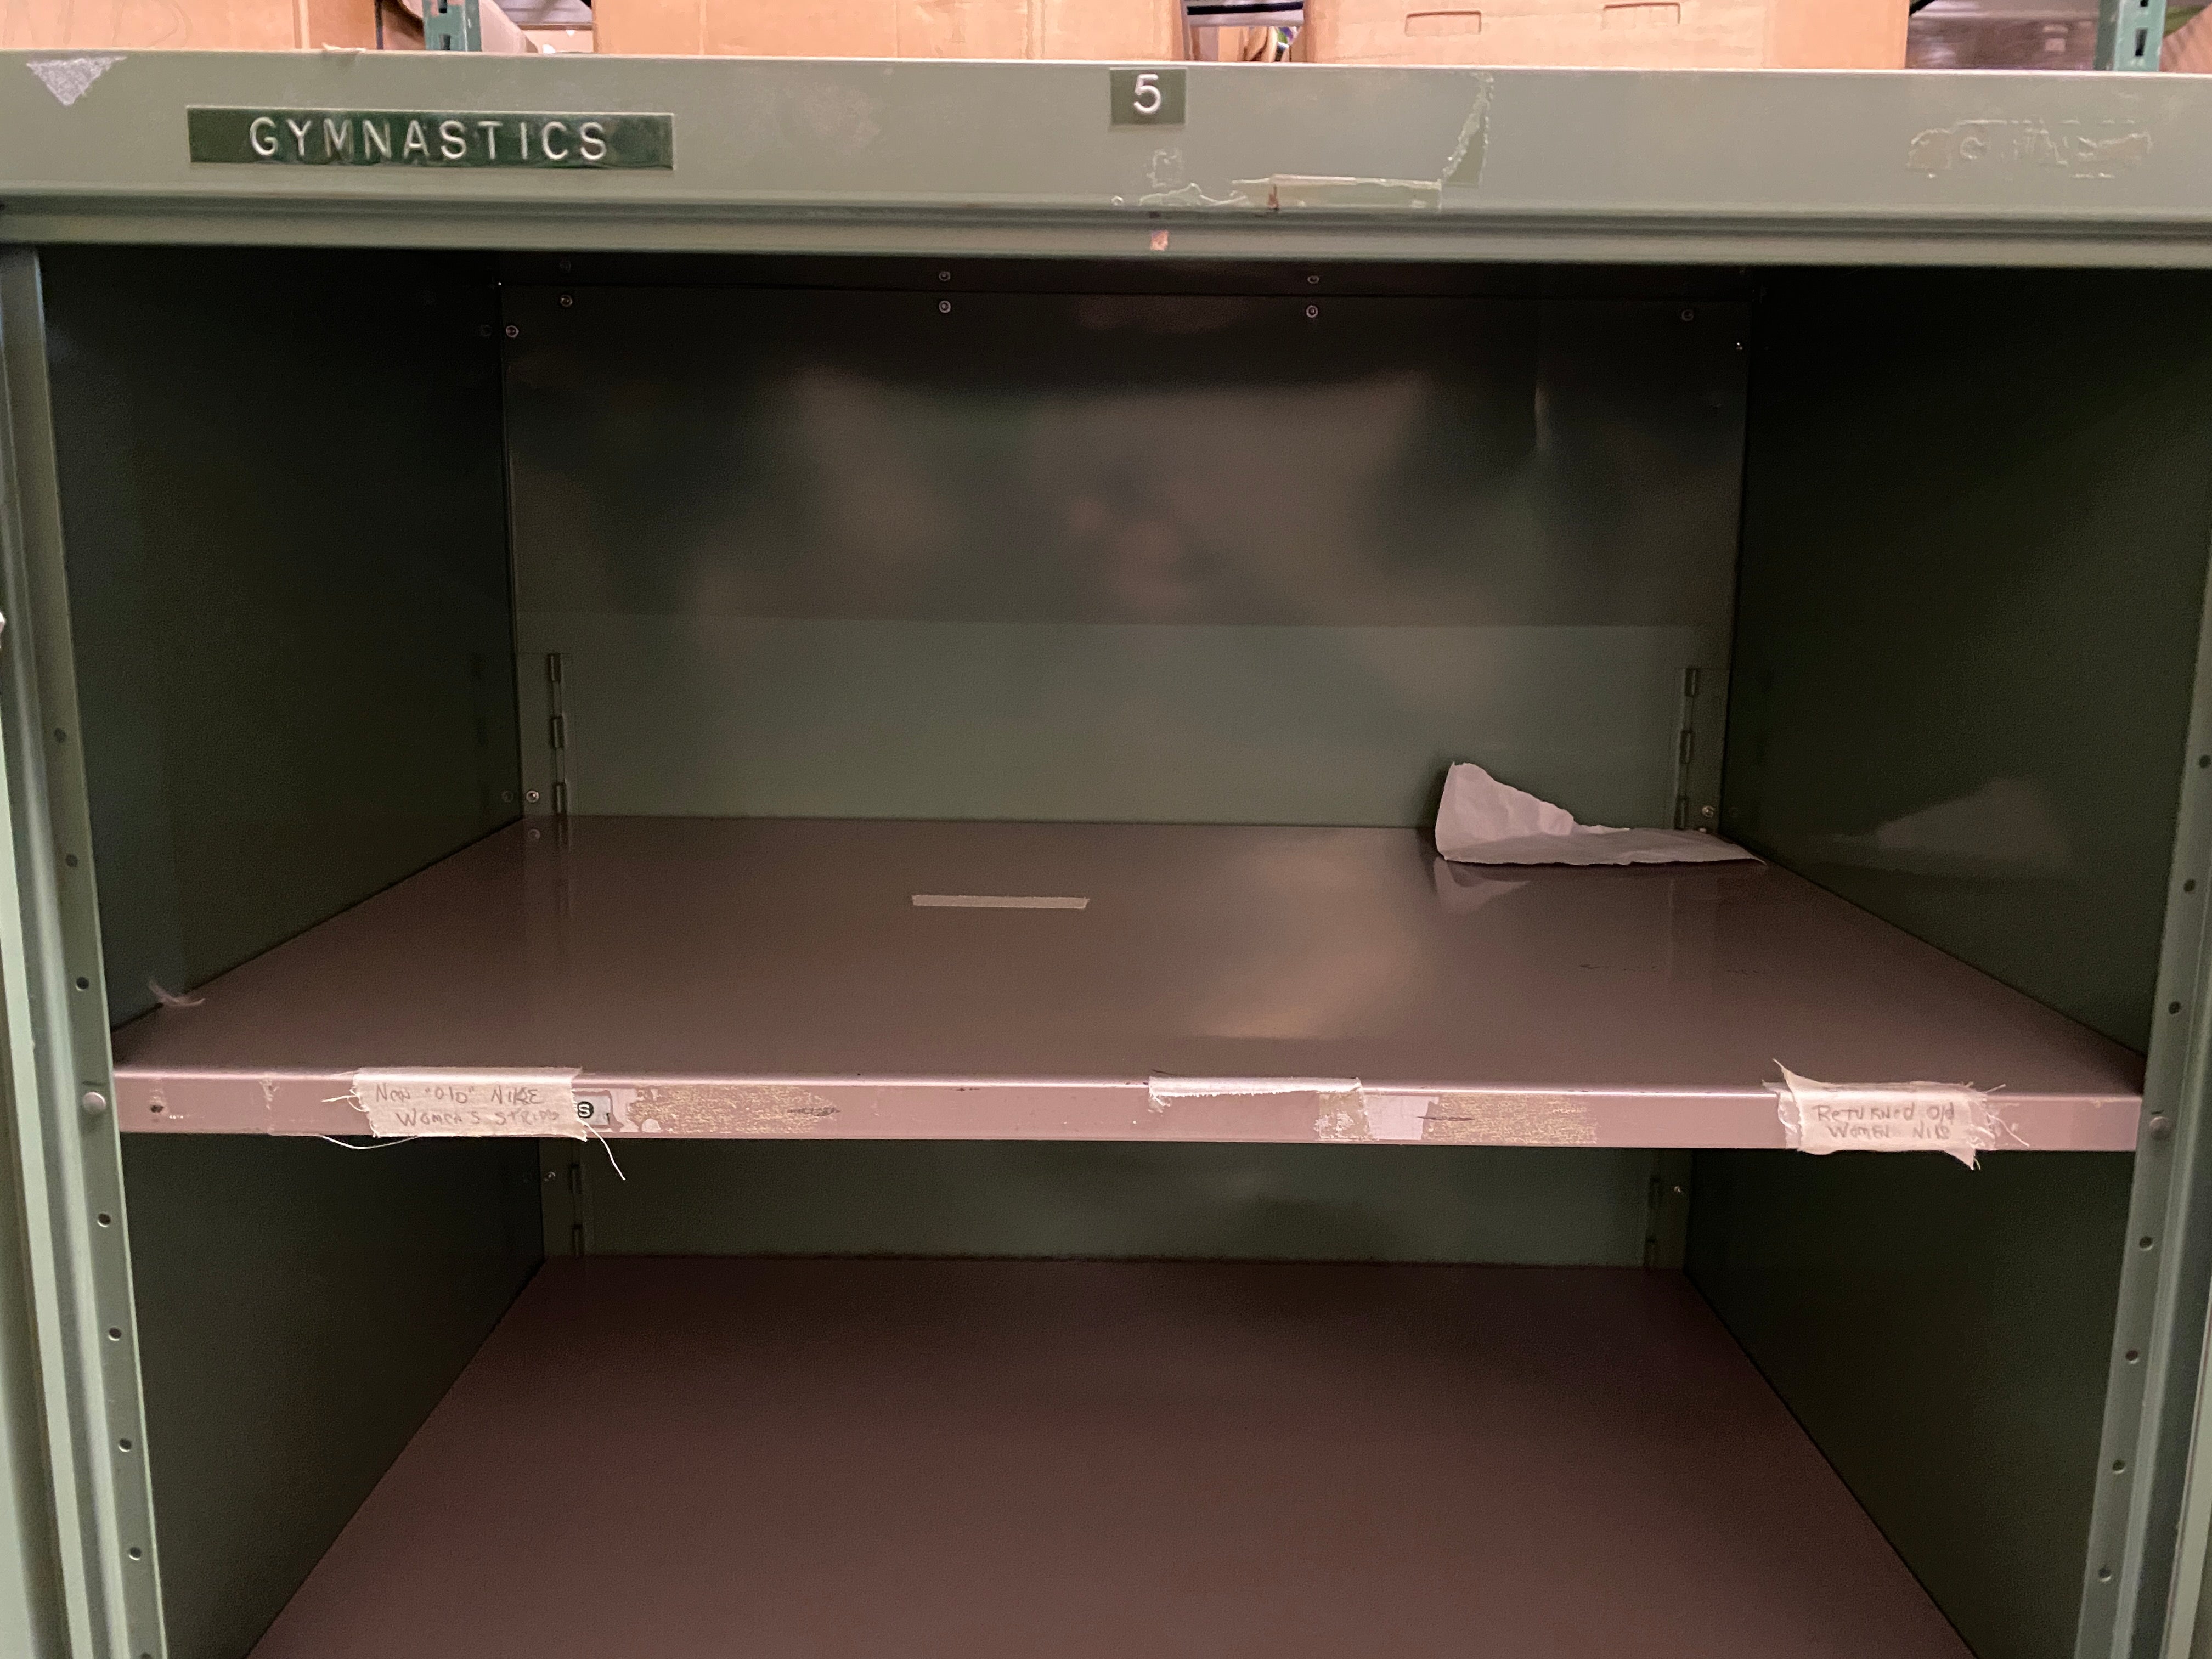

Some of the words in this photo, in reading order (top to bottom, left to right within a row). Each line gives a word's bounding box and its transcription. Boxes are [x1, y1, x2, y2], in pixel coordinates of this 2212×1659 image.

[1133, 74, 1161, 113] 5
[249, 116, 607, 161] GYMNASTICS
[578, 1103, 591, 1117] S
